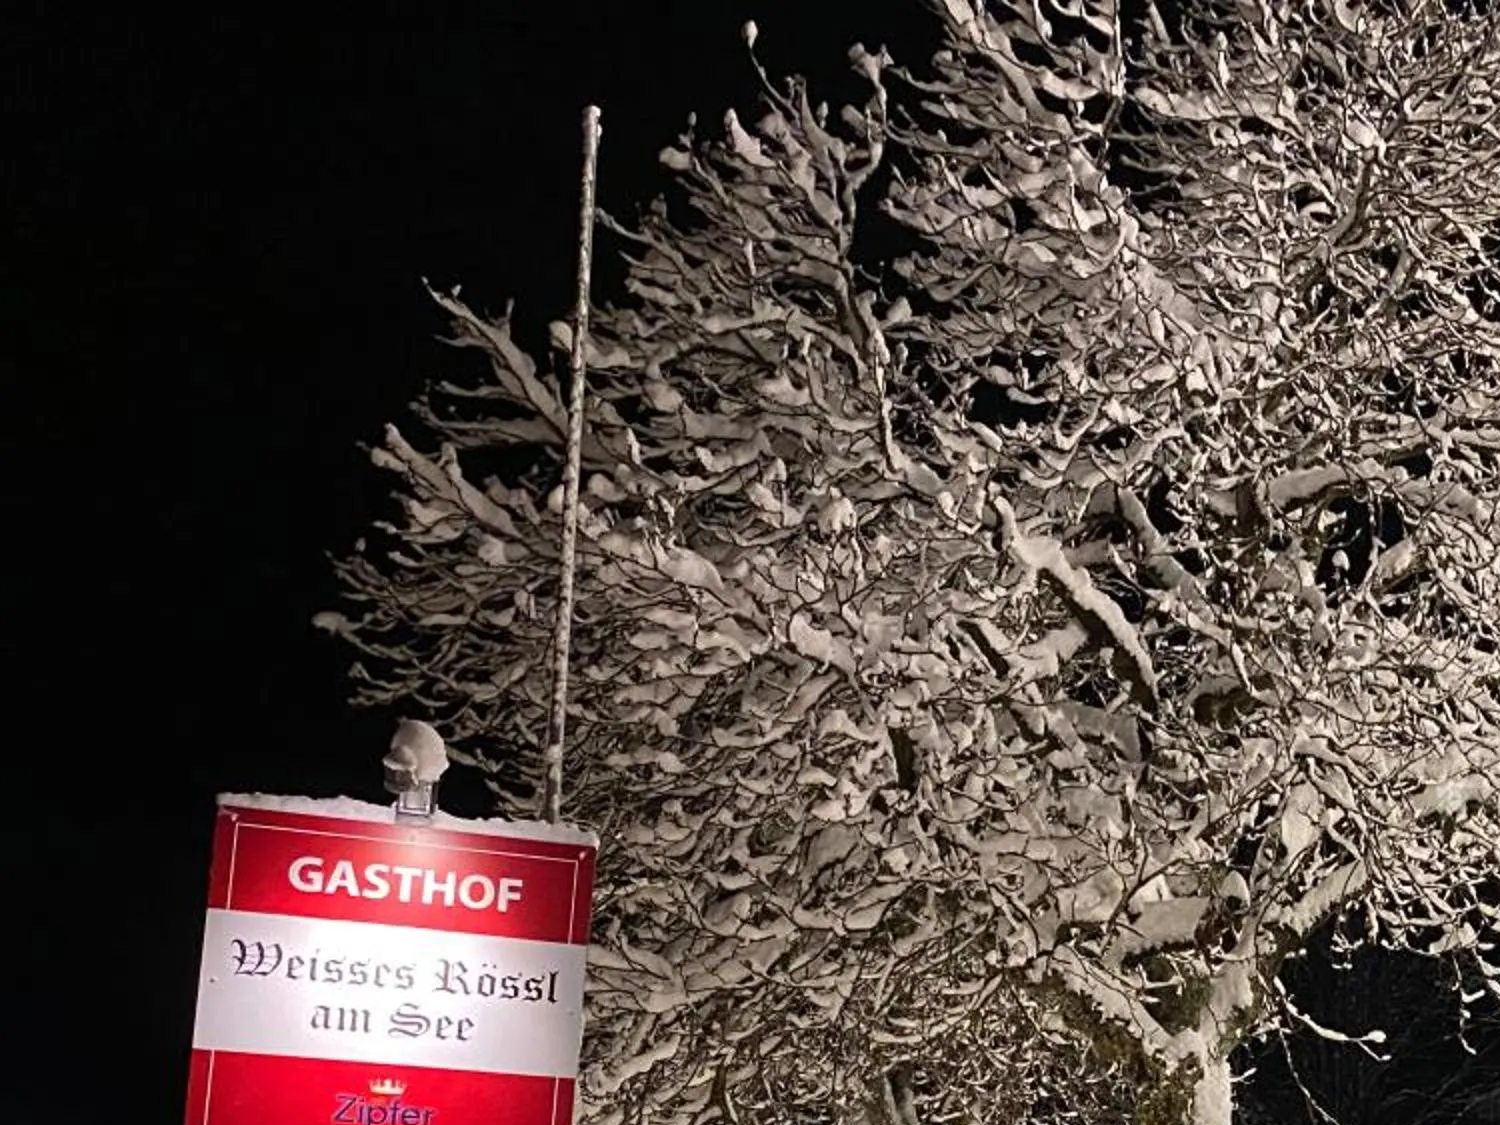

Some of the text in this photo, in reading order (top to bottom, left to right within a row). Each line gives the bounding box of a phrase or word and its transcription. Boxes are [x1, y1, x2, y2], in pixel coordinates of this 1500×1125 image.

[288, 856, 523, 913] GASTHOF
[230, 938, 559, 1004] Weisses Rössl
[310, 1002, 476, 1042] am See
